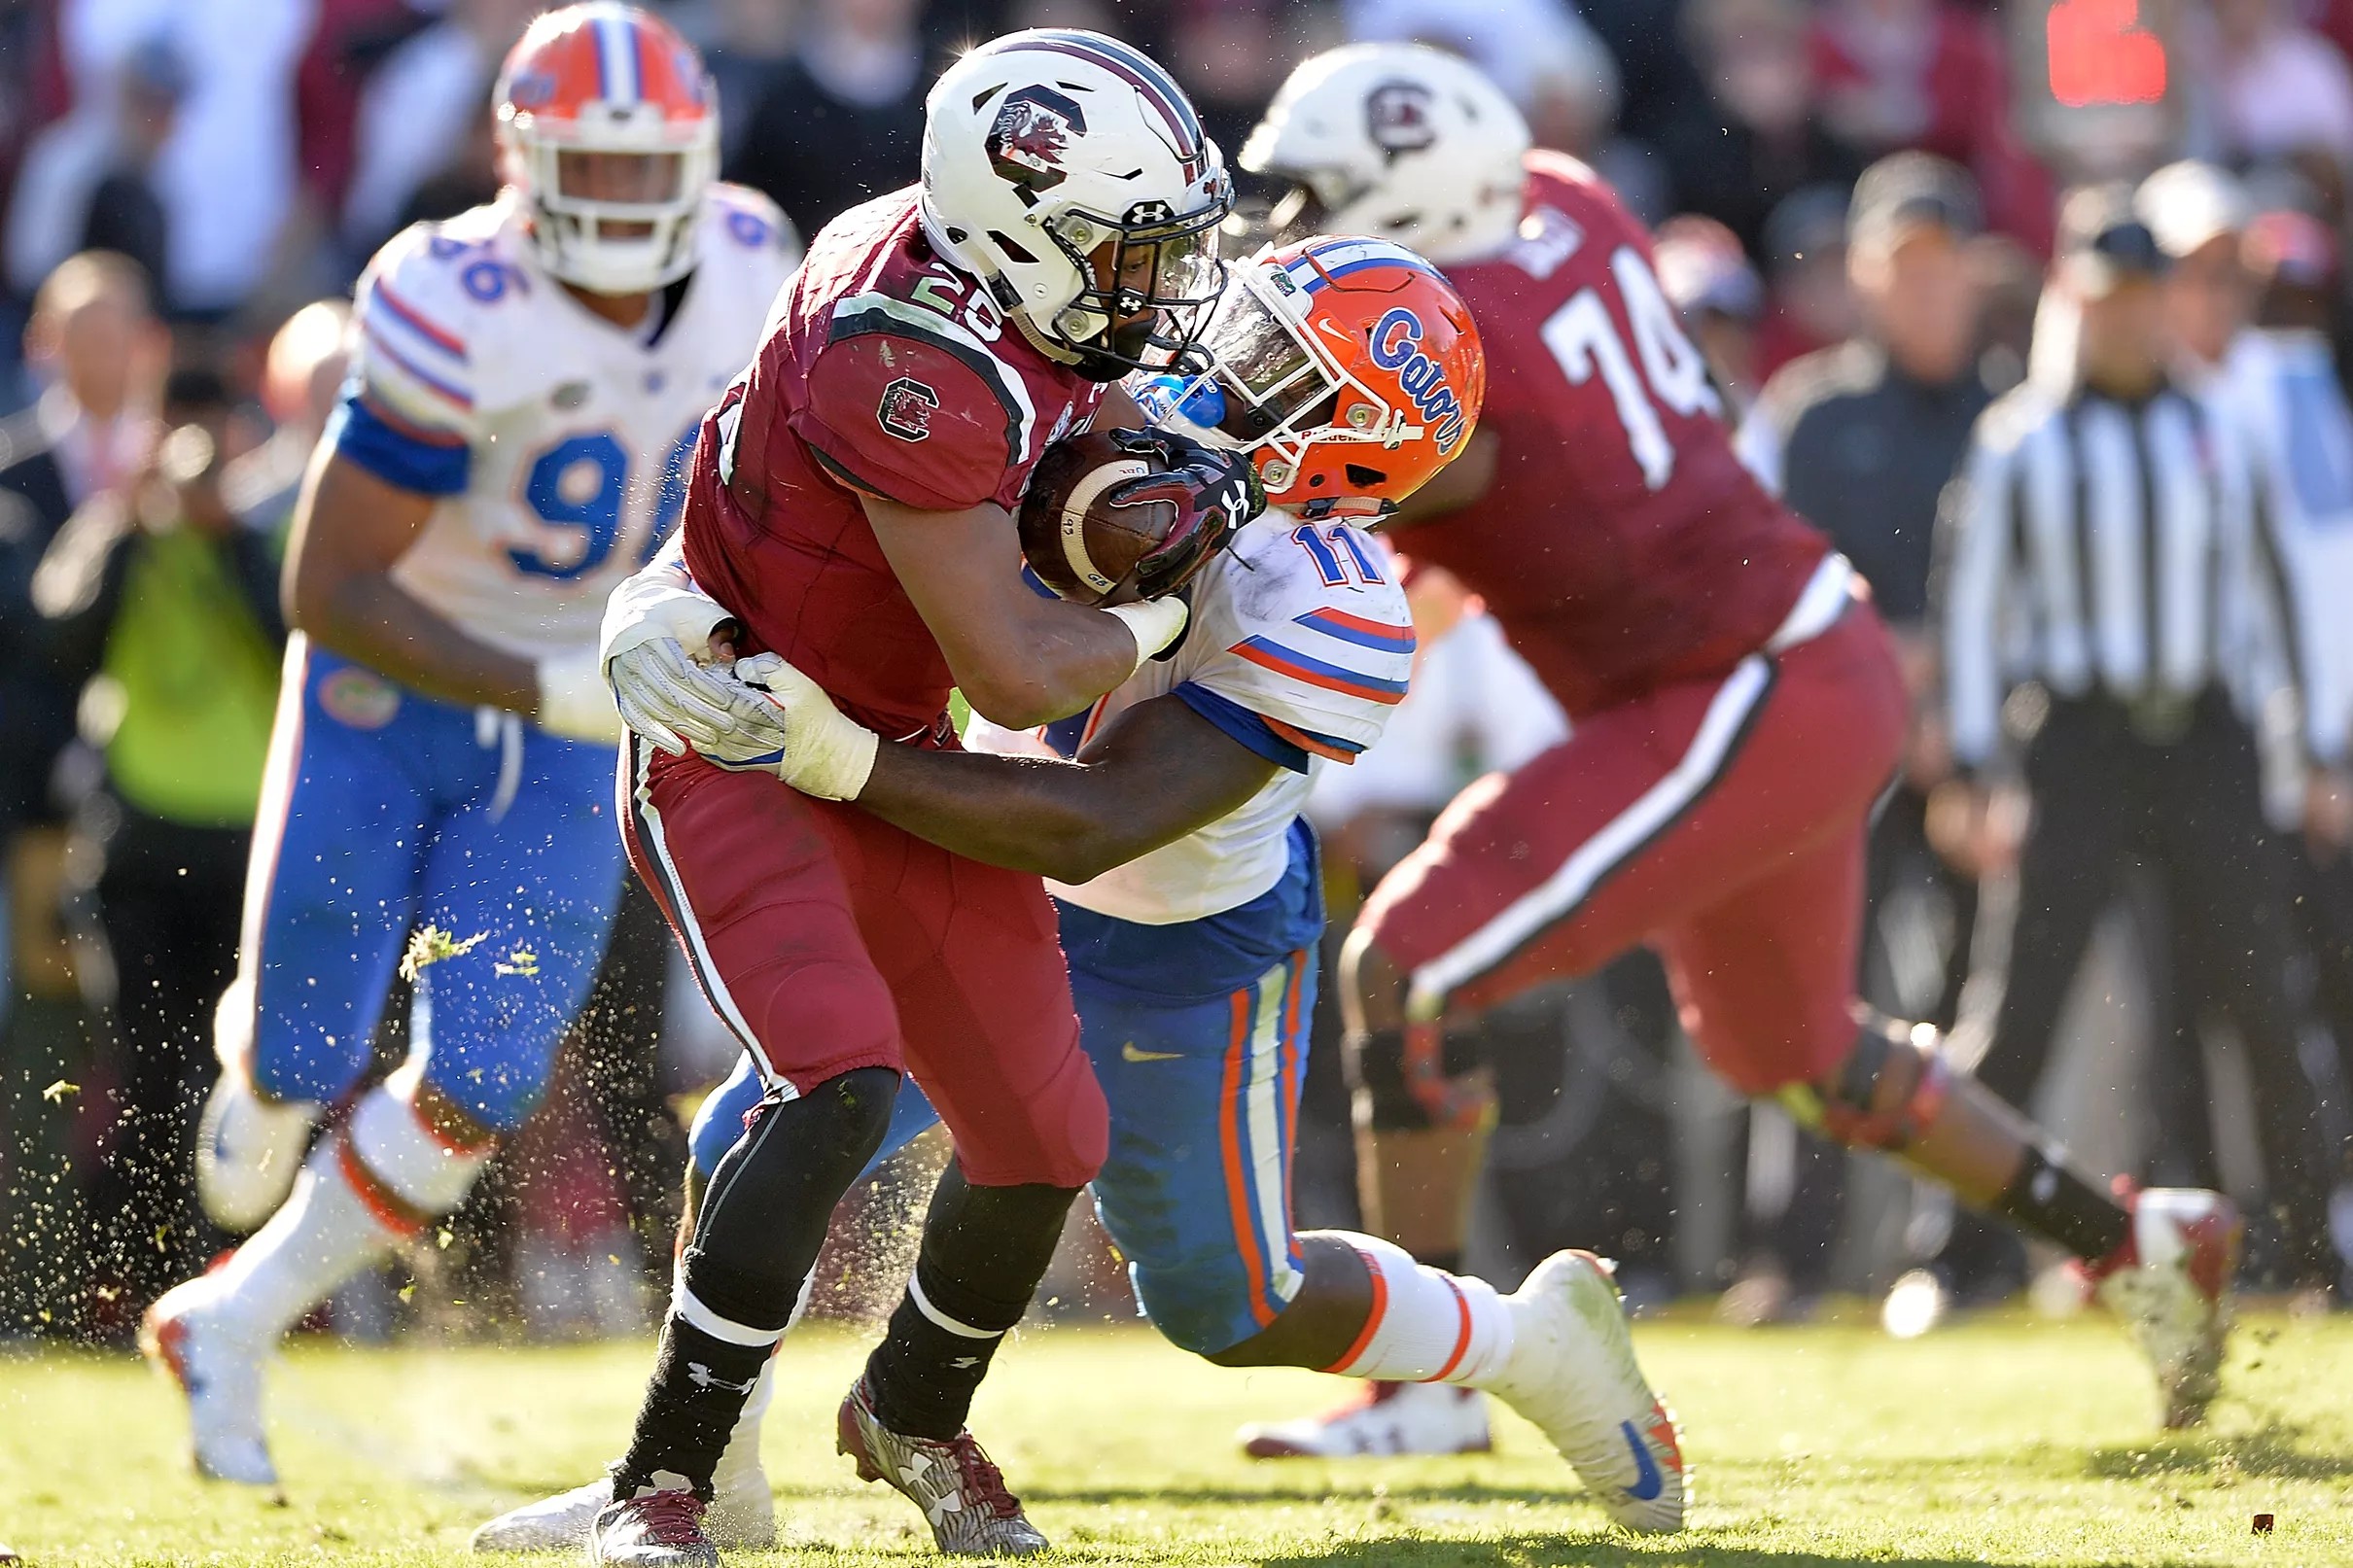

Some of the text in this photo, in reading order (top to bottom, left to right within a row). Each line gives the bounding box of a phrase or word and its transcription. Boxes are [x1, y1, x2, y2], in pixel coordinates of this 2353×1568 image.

[1369, 306, 1466, 457] Gators
[1540, 245, 1724, 492] 74
[1290, 522, 1387, 587] 11
